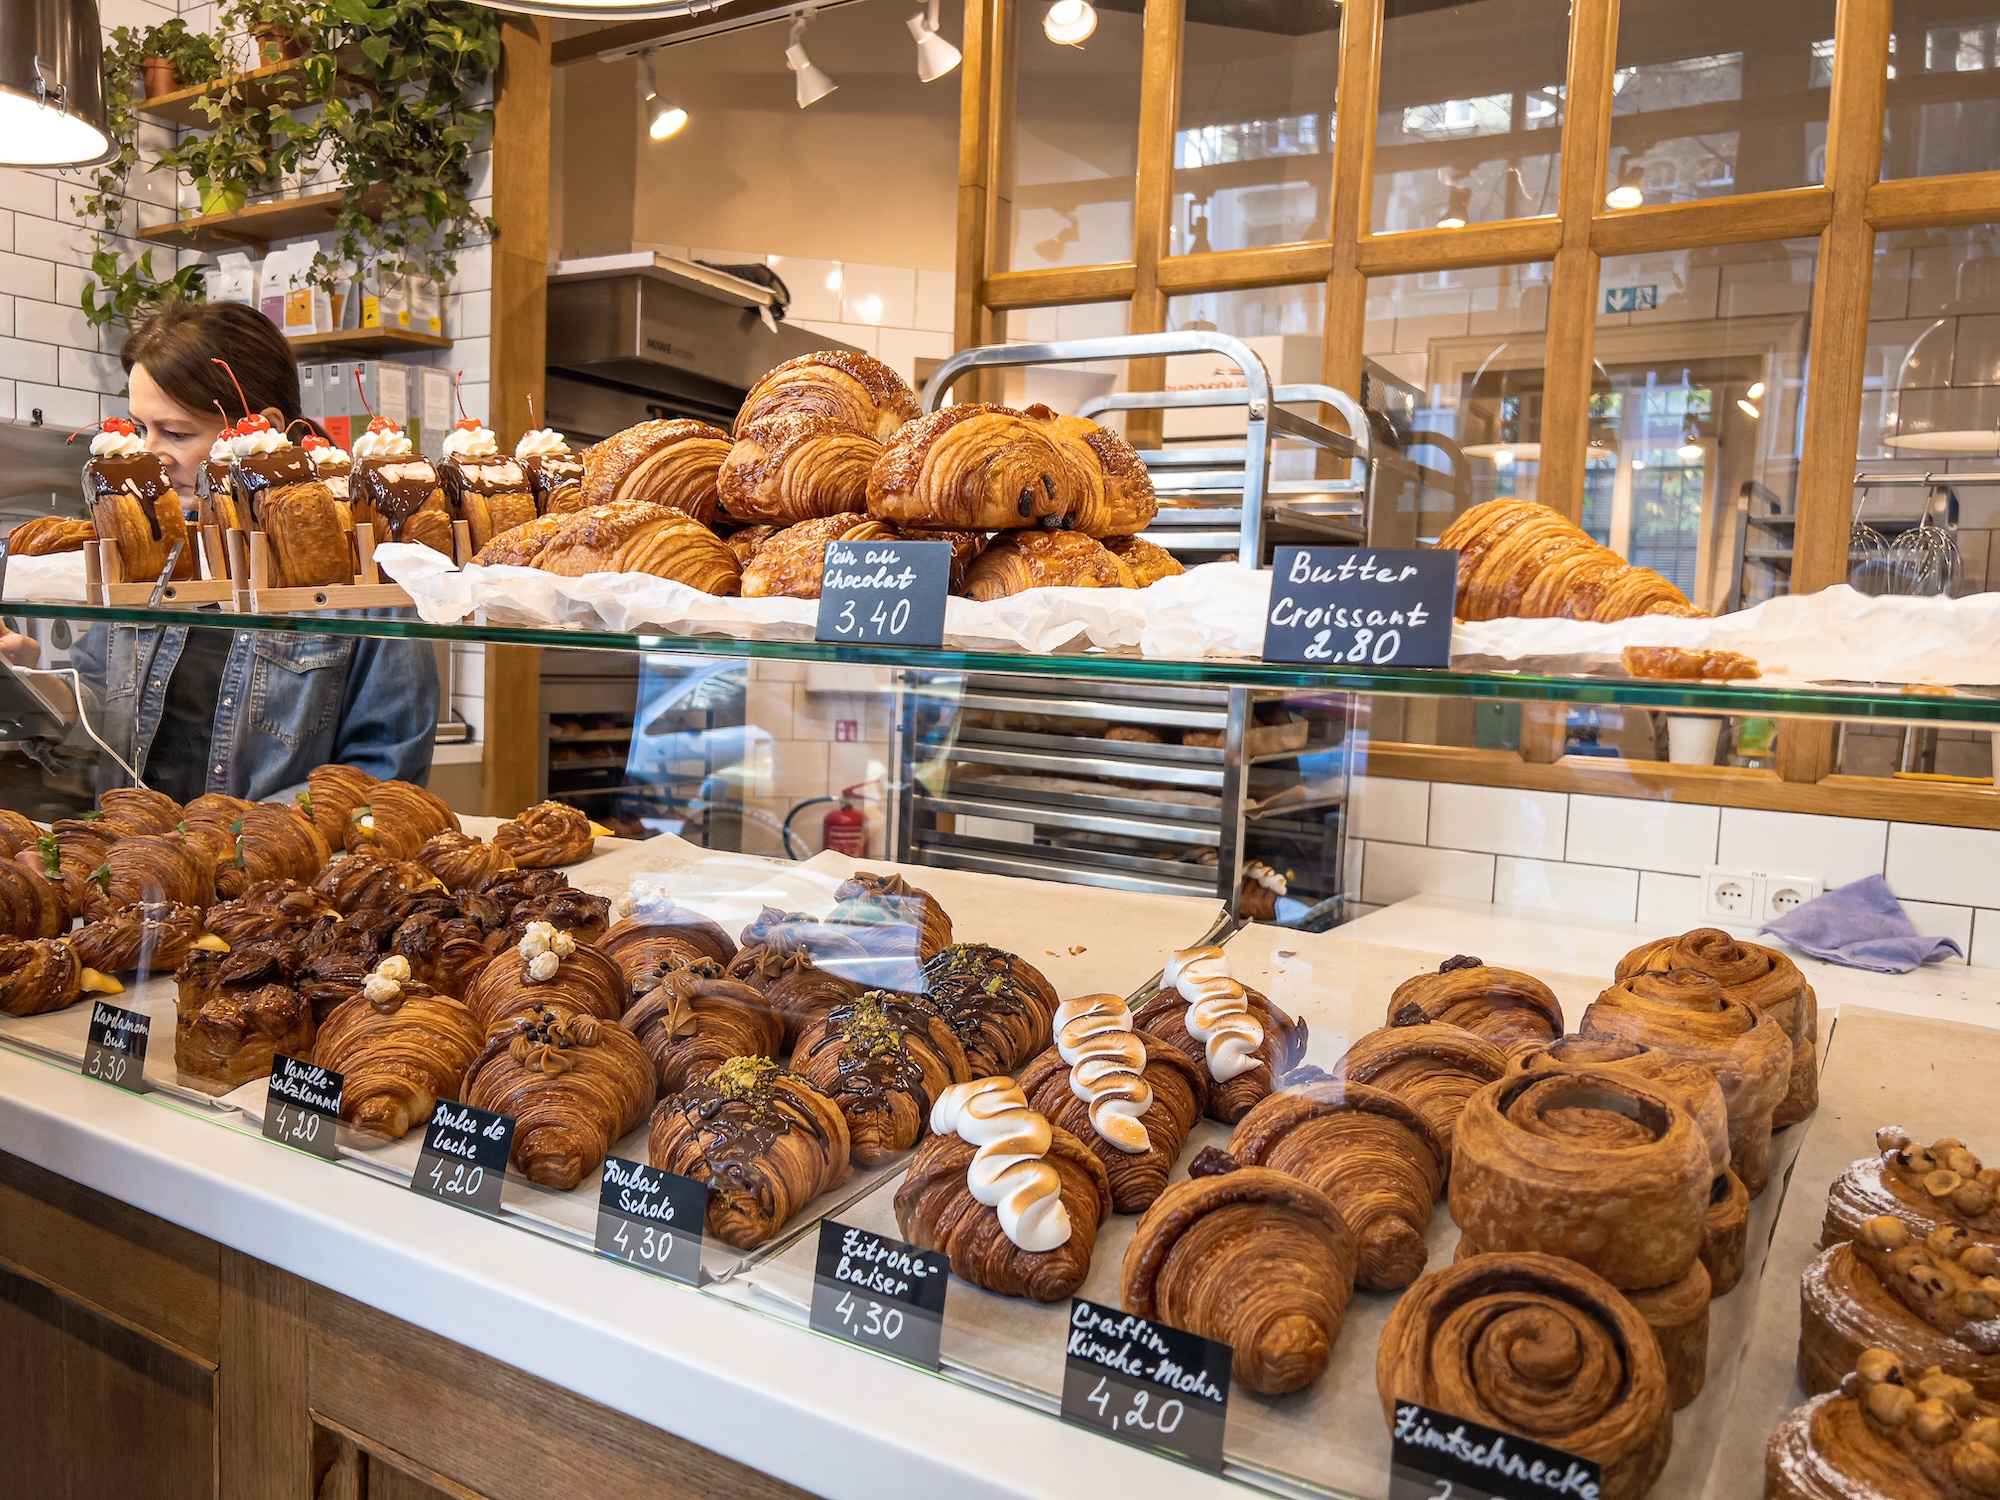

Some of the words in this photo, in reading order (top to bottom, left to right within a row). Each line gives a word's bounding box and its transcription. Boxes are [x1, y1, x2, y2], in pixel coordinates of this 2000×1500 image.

[825, 542, 858, 566] Pain
[864, 549, 901, 565] au
[1288, 551, 1419, 584] Butter
[823, 565, 917, 590] Chocolat
[835, 598, 911, 638] 3,40
[1270, 597, 1430, 629] Croissant
[1303, 628, 1402, 665] 2,80
[93, 1003, 149, 1036] Kardamom
[103, 1030, 127, 1050] Bun
[89, 1050, 126, 1083] 3,30
[284, 1058, 335, 1090] Vanille-
[275, 1104, 320, 1142] 4,20
[432, 1103, 477, 1135] Dulce
[482, 1117, 506, 1142] de
[433, 1129, 477, 1160] Leche
[429, 1157, 484, 1195] 4,20
[603, 1159, 664, 1194] Dubai
[618, 1189, 676, 1222] Schoko
[613, 1220, 674, 1263] 4,30
[841, 1228, 940, 1279] Zitrone-
[835, 1255, 910, 1296] Baiser
[834, 1290, 905, 1340] 4,30
[1087, 1375, 1184, 1433] 4,20
